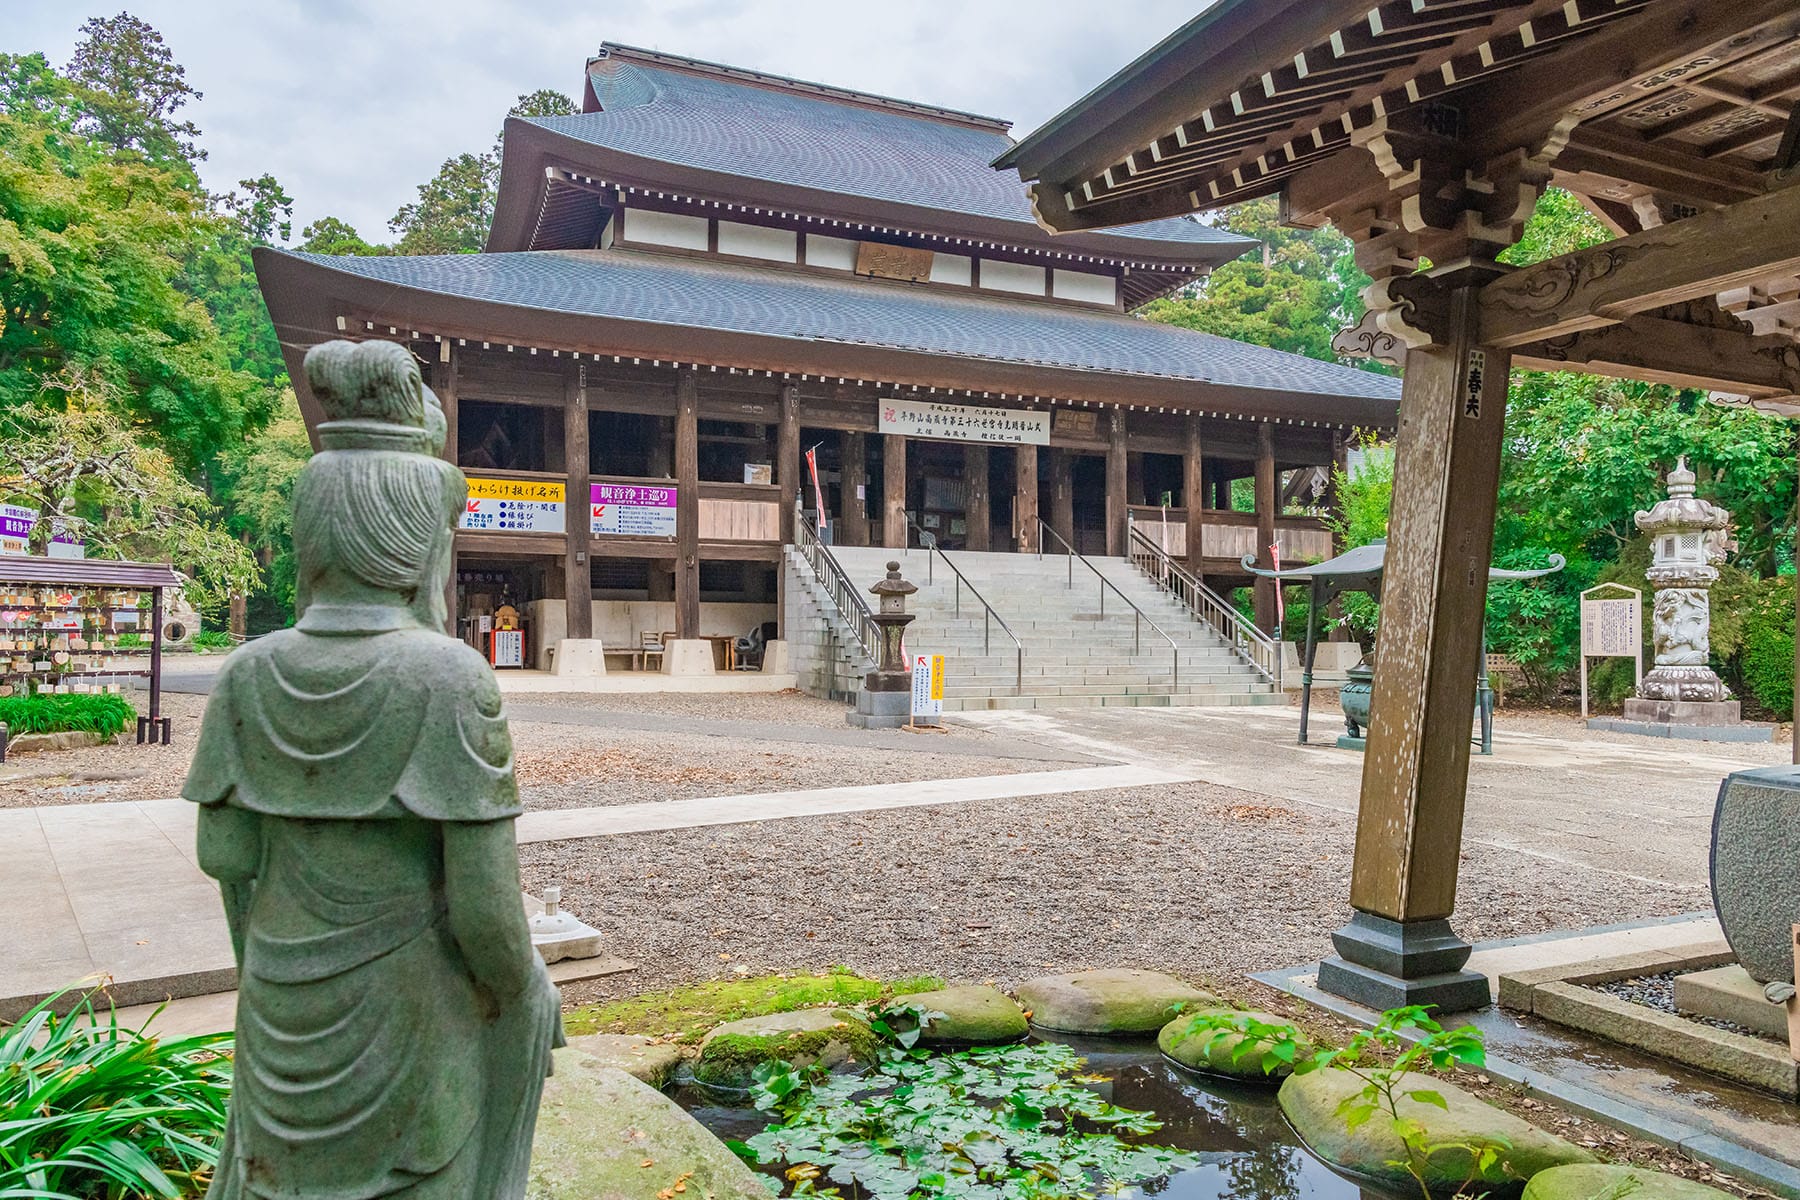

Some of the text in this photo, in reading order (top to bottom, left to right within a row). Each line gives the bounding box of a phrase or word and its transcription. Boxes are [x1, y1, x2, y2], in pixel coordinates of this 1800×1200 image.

[1465, 368, 1482, 418] 春夫
[883, 407, 897, 423] 祝
[601, 486, 668, 502] 観音浄土巡り
[508, 512, 534, 520] 縁結び
